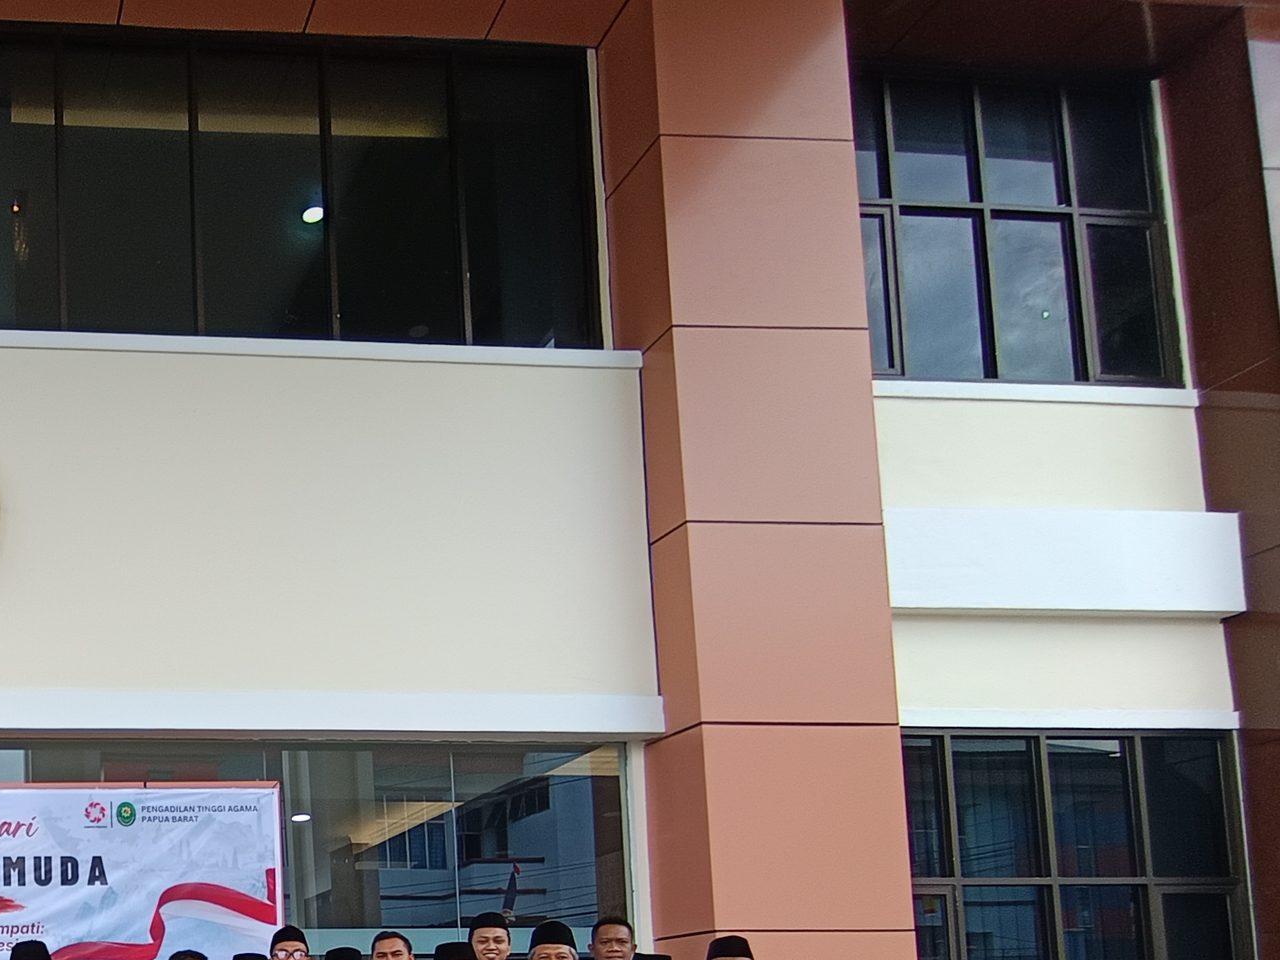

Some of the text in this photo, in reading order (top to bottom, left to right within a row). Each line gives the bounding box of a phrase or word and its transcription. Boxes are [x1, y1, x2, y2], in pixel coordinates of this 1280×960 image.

[141, 805, 258, 813] PENGADILAN TINGGI AGAMA
[141, 815, 199, 823] PAPUA BARAT
